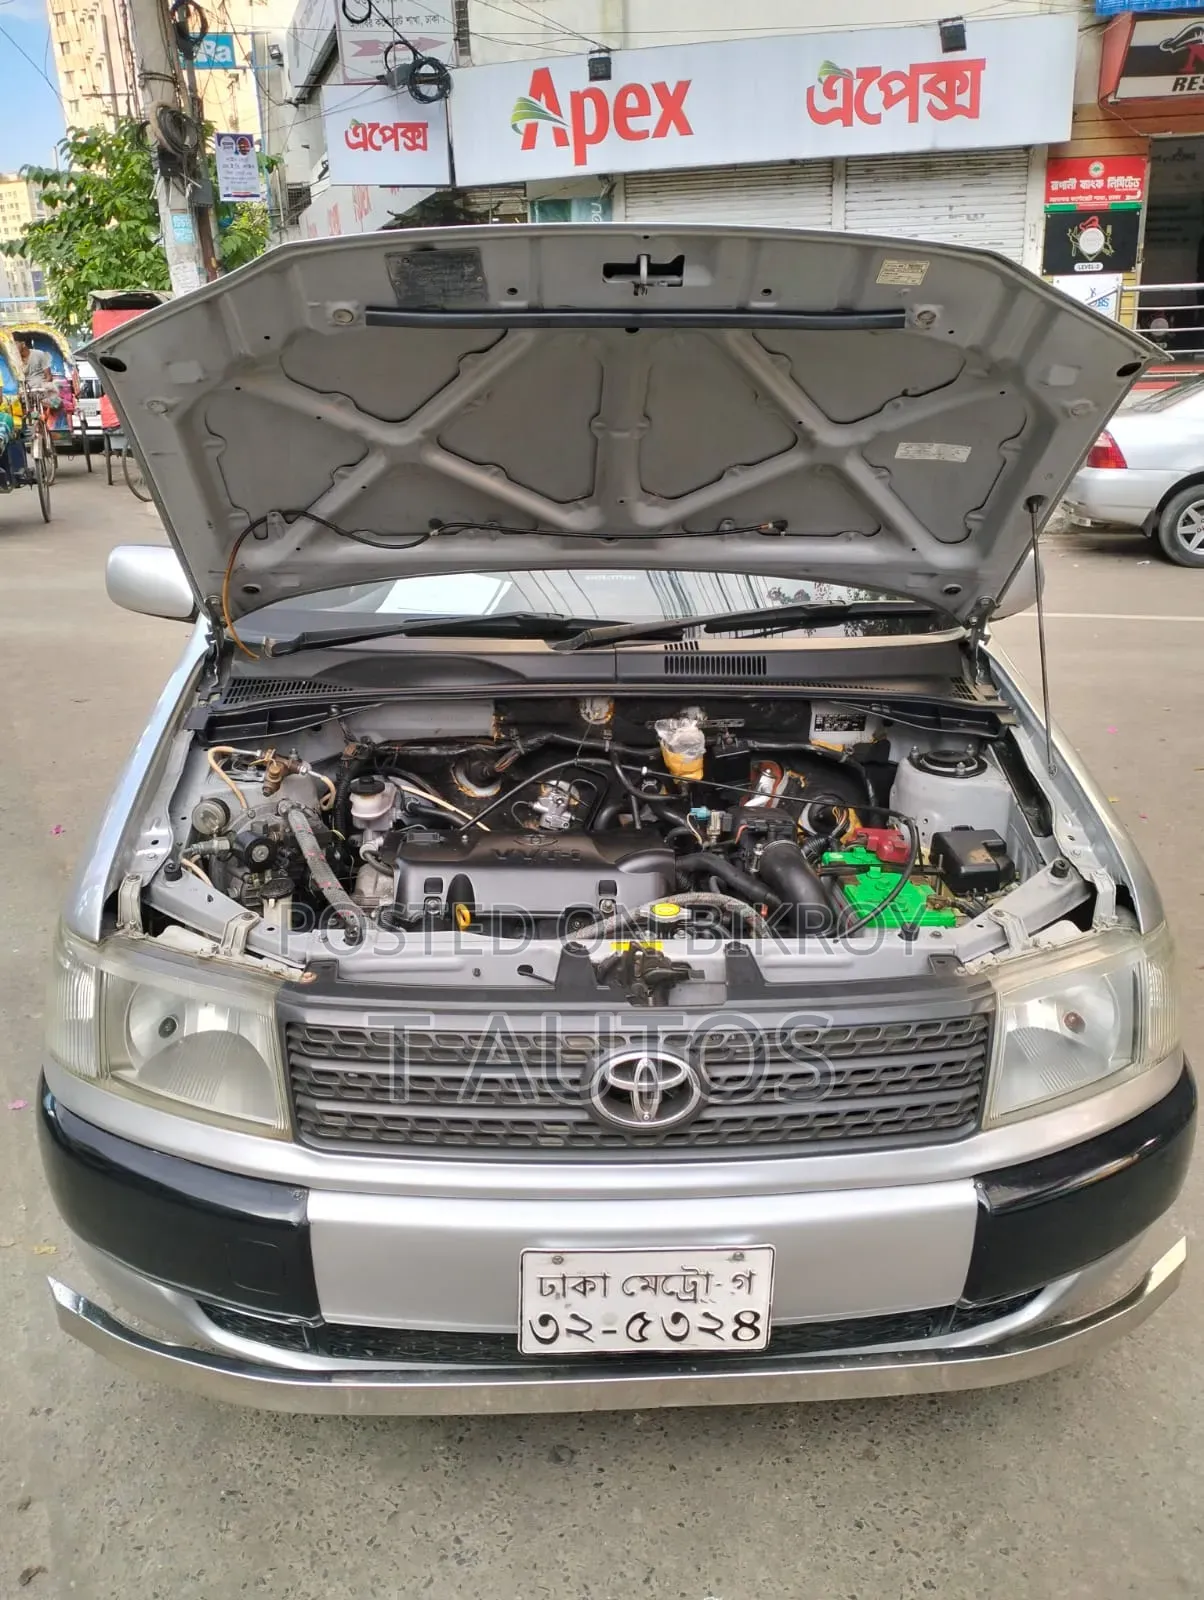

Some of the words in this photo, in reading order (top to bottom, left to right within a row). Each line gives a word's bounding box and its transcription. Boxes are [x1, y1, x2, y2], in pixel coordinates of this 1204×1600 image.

[807, 58, 986, 127] এপেক্স
[521, 67, 694, 166] Apex
[345, 122, 428, 151] এপেক্স
[536, 1272, 611, 1299] ঢাকা
[528, 1309, 762, 1345] ৩২-৫৩২৪
